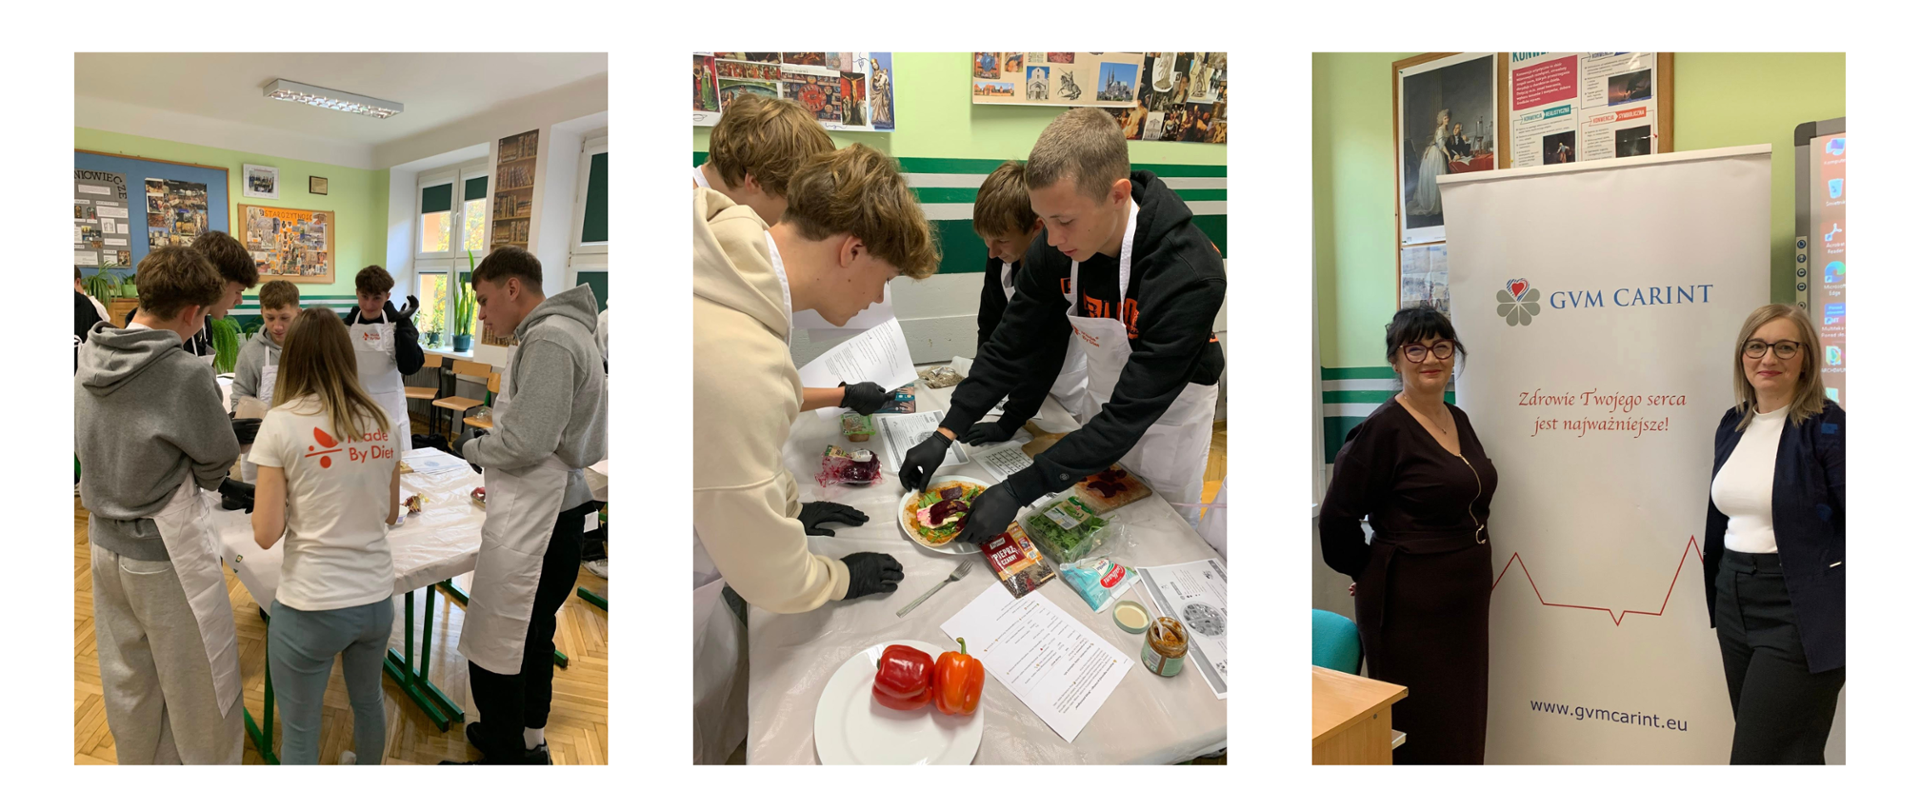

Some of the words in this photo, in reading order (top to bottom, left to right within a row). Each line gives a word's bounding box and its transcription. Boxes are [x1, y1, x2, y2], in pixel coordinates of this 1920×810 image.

[1550, 289, 1604, 309] GVM
[1613, 284, 1714, 308] CARINT
[1518, 388, 1576, 406] Zdrowie
[1580, 388, 1642, 413] Twojego
[1646, 394, 1686, 406] serca
[1530, 416, 1558, 437] jest
[1562, 416, 1670, 438] najważniejsze!
[349, 447, 368, 463] By
[371, 444, 394, 460] Diet
[992, 545, 1016, 562] PIEPRZ
[1001, 554, 1017, 566] CZARNY
[1530, 700, 1688, 732] www.gvmcarint.eu
